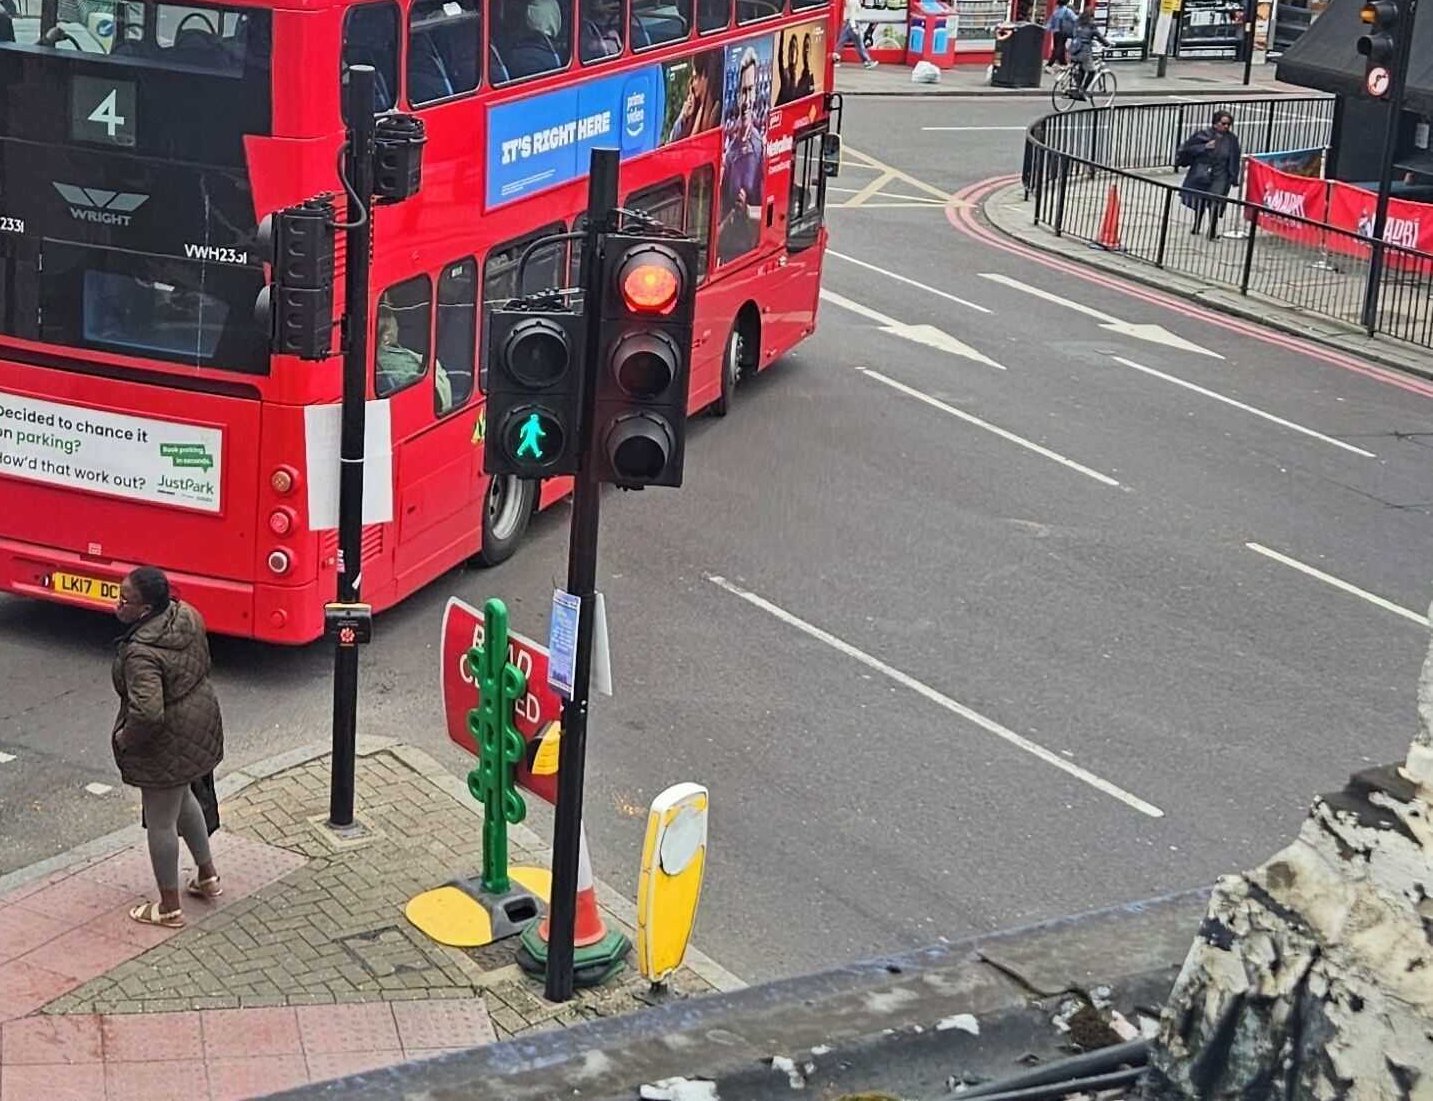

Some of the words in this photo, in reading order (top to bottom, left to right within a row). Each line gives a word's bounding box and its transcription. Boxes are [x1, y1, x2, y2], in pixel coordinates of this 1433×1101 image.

[87, 89, 125, 136] 4
[627, 93, 645, 111] prime
[627, 107, 645, 124] video
[502, 135, 531, 165] IT'S
[533, 121, 577, 154] RIGHT
[577, 111, 611, 140] HERE
[70, 207, 132, 226] WRIGHT
[16, 430, 81, 455] parking?
[58, 416, 73, 430] to
[76, 420, 134, 440] chance
[137, 428, 148, 443] it
[41, 459, 71, 476] that
[74, 467, 110, 483] work
[113, 476, 146, 490] out?
[158, 475, 215, 495] JustPark
[62, 575, 93, 594] LK17
[101, 582, 119, 599] DC
[473, 623, 533, 681] RD
[459, 653, 541, 724] CED
